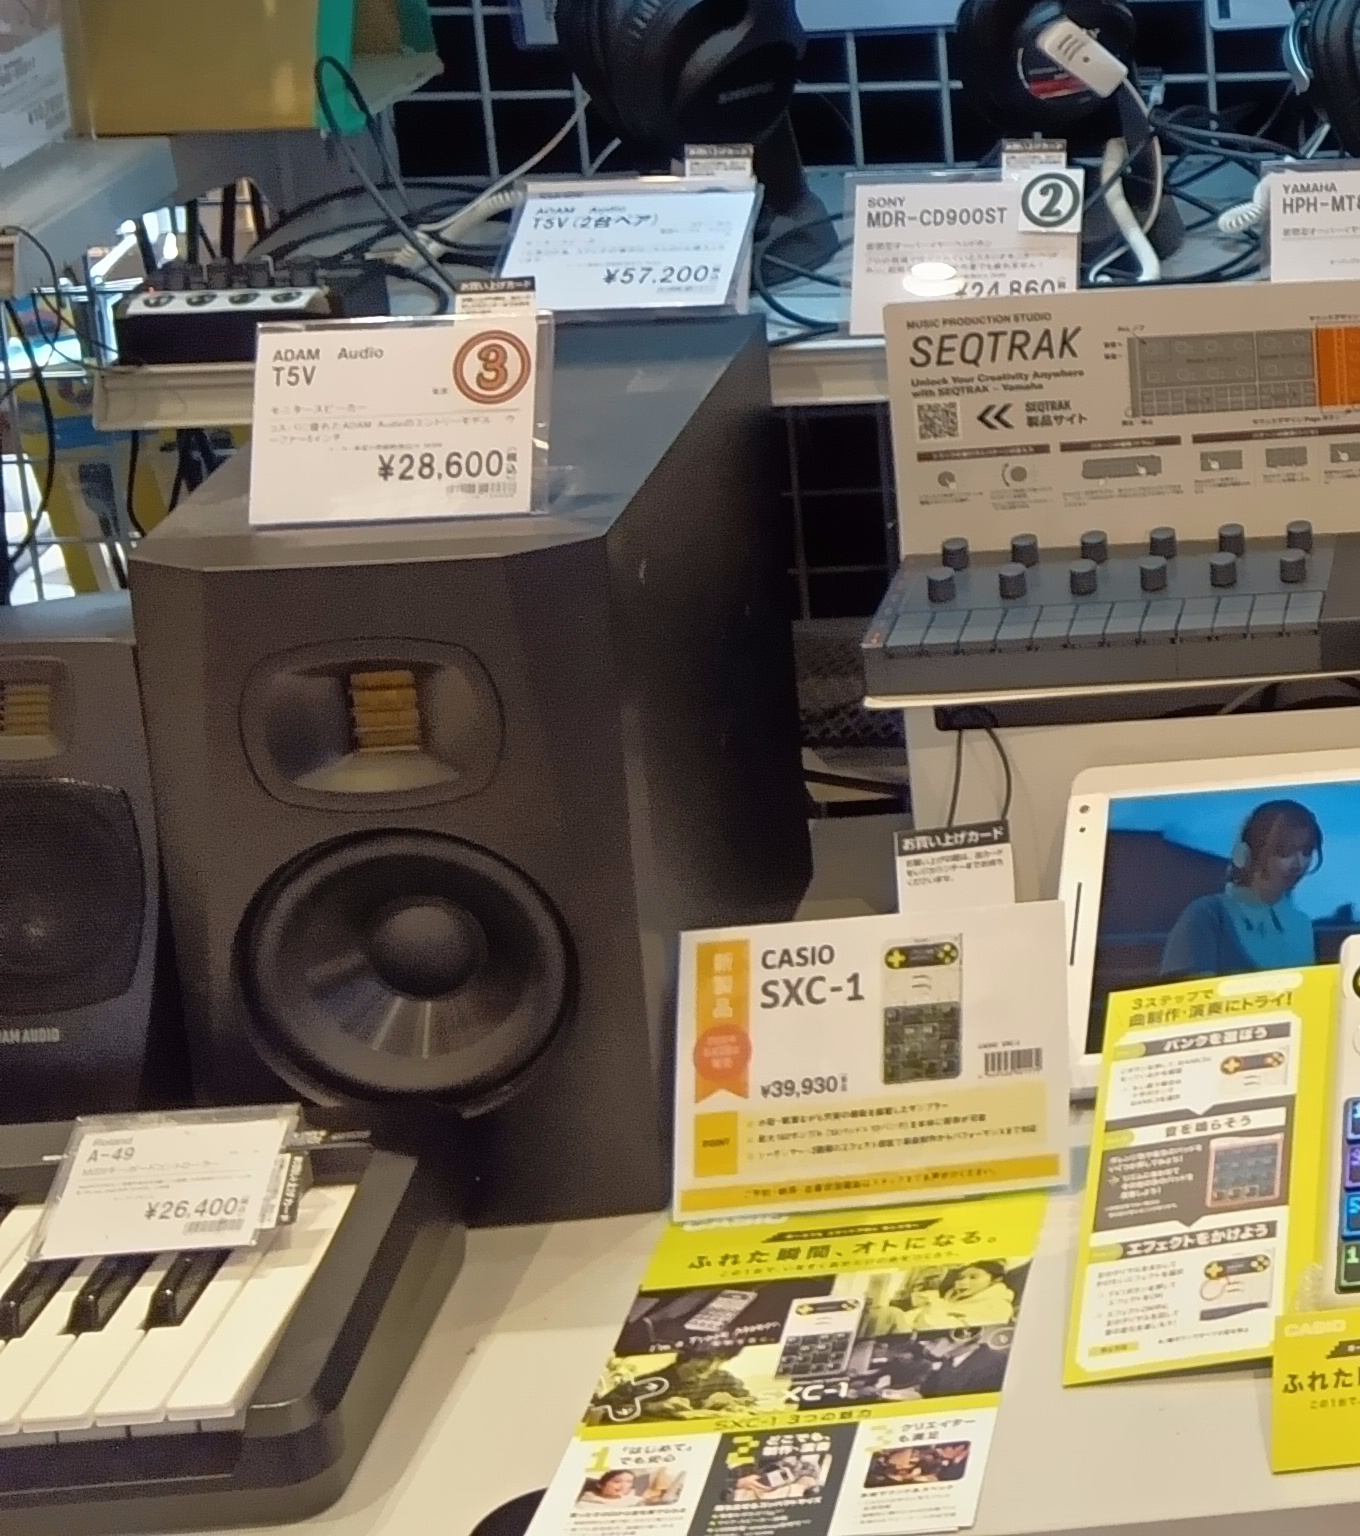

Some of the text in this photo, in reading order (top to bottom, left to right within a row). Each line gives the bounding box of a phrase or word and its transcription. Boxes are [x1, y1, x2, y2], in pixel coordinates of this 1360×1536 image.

[1282, 182, 1338, 194] YAMAHA
[867, 196, 906, 209] SONY
[866, 207, 1008, 228] MDR-CD900ST
[602, 265, 710, 285] ¥57,200
[906, 312, 1053, 330] MUSIC PRODUCTION STUDIO
[272, 345, 384, 363] ADAM Audio
[909, 325, 1083, 369] SEQTRAK
[272, 364, 317, 388] T5V
[910, 368, 1085, 389] Unlock Your Creativity Anywhere
[911, 382, 1044, 398] with SEQTRAK Yamaha
[1024, 400, 1072, 413] SEQTRAK
[378, 449, 504, 482] ¥28,600
[901, 826, 1005, 852] お買い上げカード
[760, 943, 836, 970] CASIO
[759, 972, 866, 1010] SXC-1
[1131, 989, 1214, 1011] 3ステップで
[22, 1026, 60, 1044] AUDIO
[760, 1075, 839, 1099] ¥39,930
[86, 1146, 136, 1164] A-49
[144, 1196, 239, 1221] ¥26,400
[687, 1228, 998, 1270] ふれた瞬間、オトになる。
[1126, 1223, 1270, 1256] エフェクトをかけよう
[1346, 1246, 1360, 1264] 1
